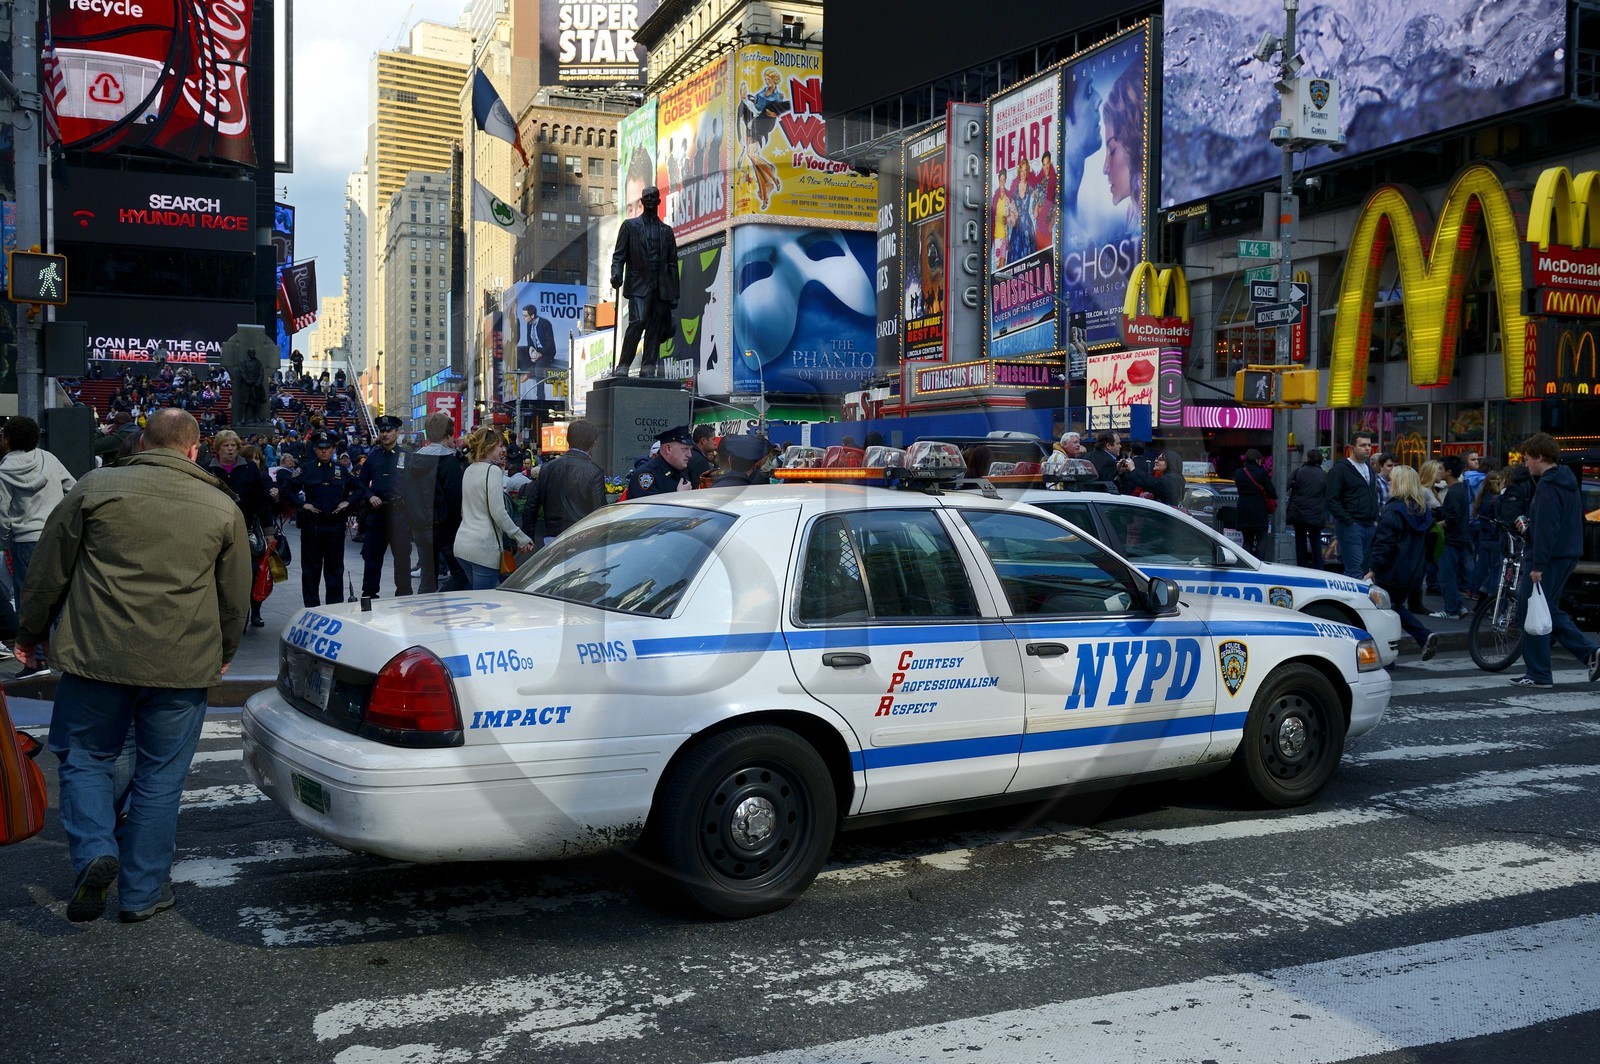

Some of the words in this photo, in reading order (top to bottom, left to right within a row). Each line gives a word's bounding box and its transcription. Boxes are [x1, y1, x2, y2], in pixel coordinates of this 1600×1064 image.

[69, 0, 144, 18] recycle
[559, 4, 640, 31] SUPER
[559, 30, 639, 63] STAR
[774, 50, 819, 70] BRODERICK
[686, 60, 727, 96] CROWD
[663, 99, 692, 126] GOES
[1310, 110, 1329, 120] SECURITY
[996, 114, 1053, 174] HEART
[793, 153, 803, 167] If
[805, 156, 824, 171] You
[823, 177, 849, 189] Musical
[851, 180, 875, 192] Comedy
[916, 158, 946, 194] Wa
[149, 194, 220, 213] SEARCH
[664, 182, 697, 228] JERSEY
[699, 171, 725, 217] BOYS
[119, 208, 195, 228] HYUNDAI
[201, 214, 249, 231] RACE
[963, 120, 980, 308] PALACE
[1240, 242, 1247, 255] W
[1248, 242, 1259, 256] 46
[1261, 243, 1268, 251] ST
[1064, 236, 1140, 286] GHOST
[1538, 257, 1600, 276] McDonal
[993, 262, 1053, 313] PRISCILLA
[1256, 287, 1272, 297] ONE
[540, 291, 578, 306] men
[540, 305, 549, 313] at
[994, 309, 1011, 323] QUEEN
[1012, 307, 1020, 316] OF
[1021, 304, 1031, 314] THE
[1261, 311, 1275, 322] ONE
[1280, 308, 1296, 319] WAY
[908, 322, 912, 331] 5
[913, 319, 923, 330] TONY
[1128, 323, 1190, 337] McDonald's
[95, 336, 125, 350] CAN
[129, 337, 162, 350] PLAY
[165, 339, 192, 352] THE
[907, 327, 929, 343] BEST
[1138, 335, 1179, 344] Restaurant
[830, 339, 855, 351] THE
[93, 348, 105, 360] IN
[109, 349, 149, 362] TIMES
[792, 350, 876, 370] PHANTO
[1111, 353, 1132, 361] POPULAR
[798, 369, 814, 381] OF
[816, 369, 842, 381] THE
[922, 367, 967, 391] OUTRAGEOUS
[968, 365, 986, 384] FUN!
[995, 365, 1049, 383] PRISCILLA
[1090, 363, 1126, 406] Psycho
[1116, 387, 1153, 411] Therapy
[634, 417, 669, 427] GEORGE
[1328, 579, 1357, 593] POLICE
[298, 611, 343, 636] NYPD
[1316, 623, 1355, 639] POLICE
[287, 625, 342, 660] POLICE
[1225, 642, 1241, 650] POLICE
[576, 640, 628, 665] PBMS
[1064, 638, 1201, 711] NYPD
[470, 705, 572, 729] IMPACT
